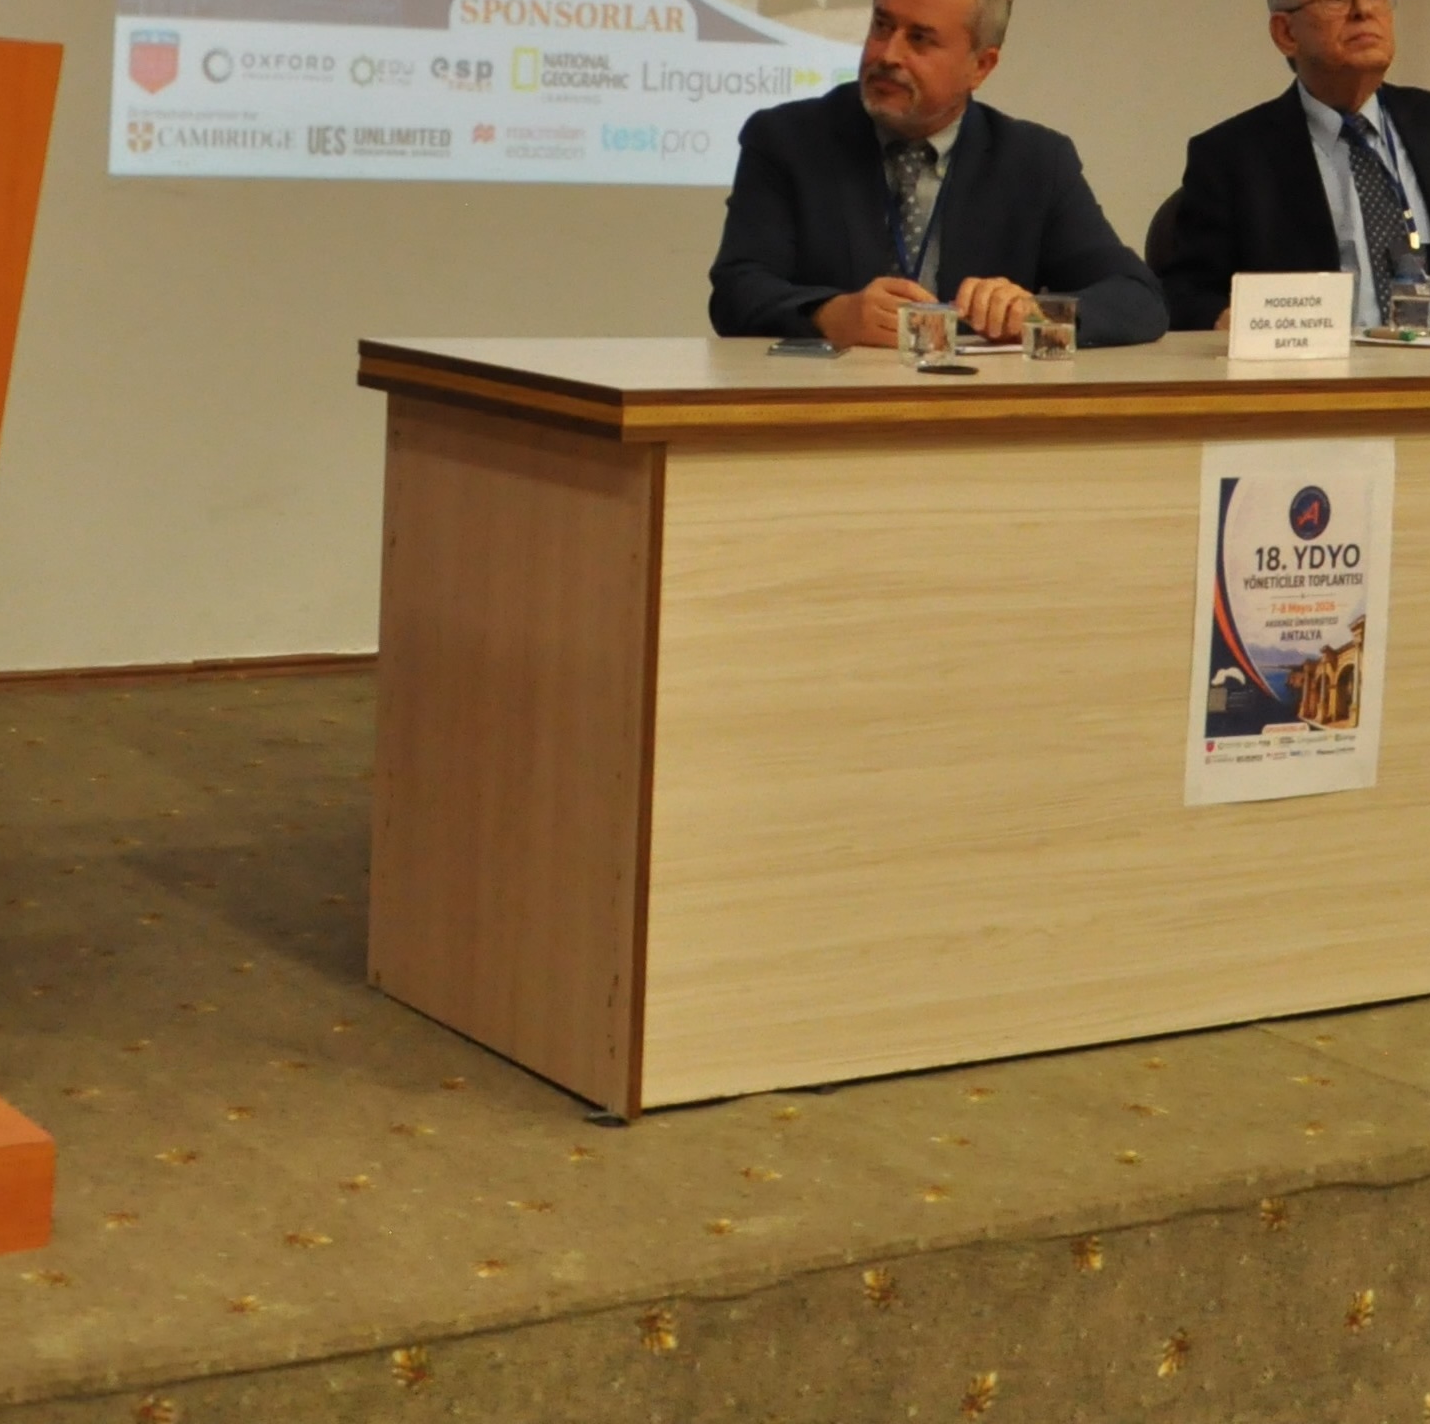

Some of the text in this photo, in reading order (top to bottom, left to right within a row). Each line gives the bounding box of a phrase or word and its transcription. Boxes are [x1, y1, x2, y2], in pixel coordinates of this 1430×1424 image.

[241, 53, 336, 72] OXFORD
[543, 52, 611, 71] NATIONAL
[541, 71, 631, 90] GEOGRAPHIC
[641, 61, 793, 102] Linguaskill
[157, 126, 295, 151] CAMBRIDGE
[307, 125, 452, 156] UES UNLIMITED
[1265, 294, 1322, 308] MODERATÖR
[1275, 338, 1308, 348] BAYTAR
[1255, 544, 1361, 571] 18. YDYO
[1243, 573, 1363, 590] YÖNETİCİLER TOPLANTISI
[1280, 629, 1322, 642] ANTALYA
